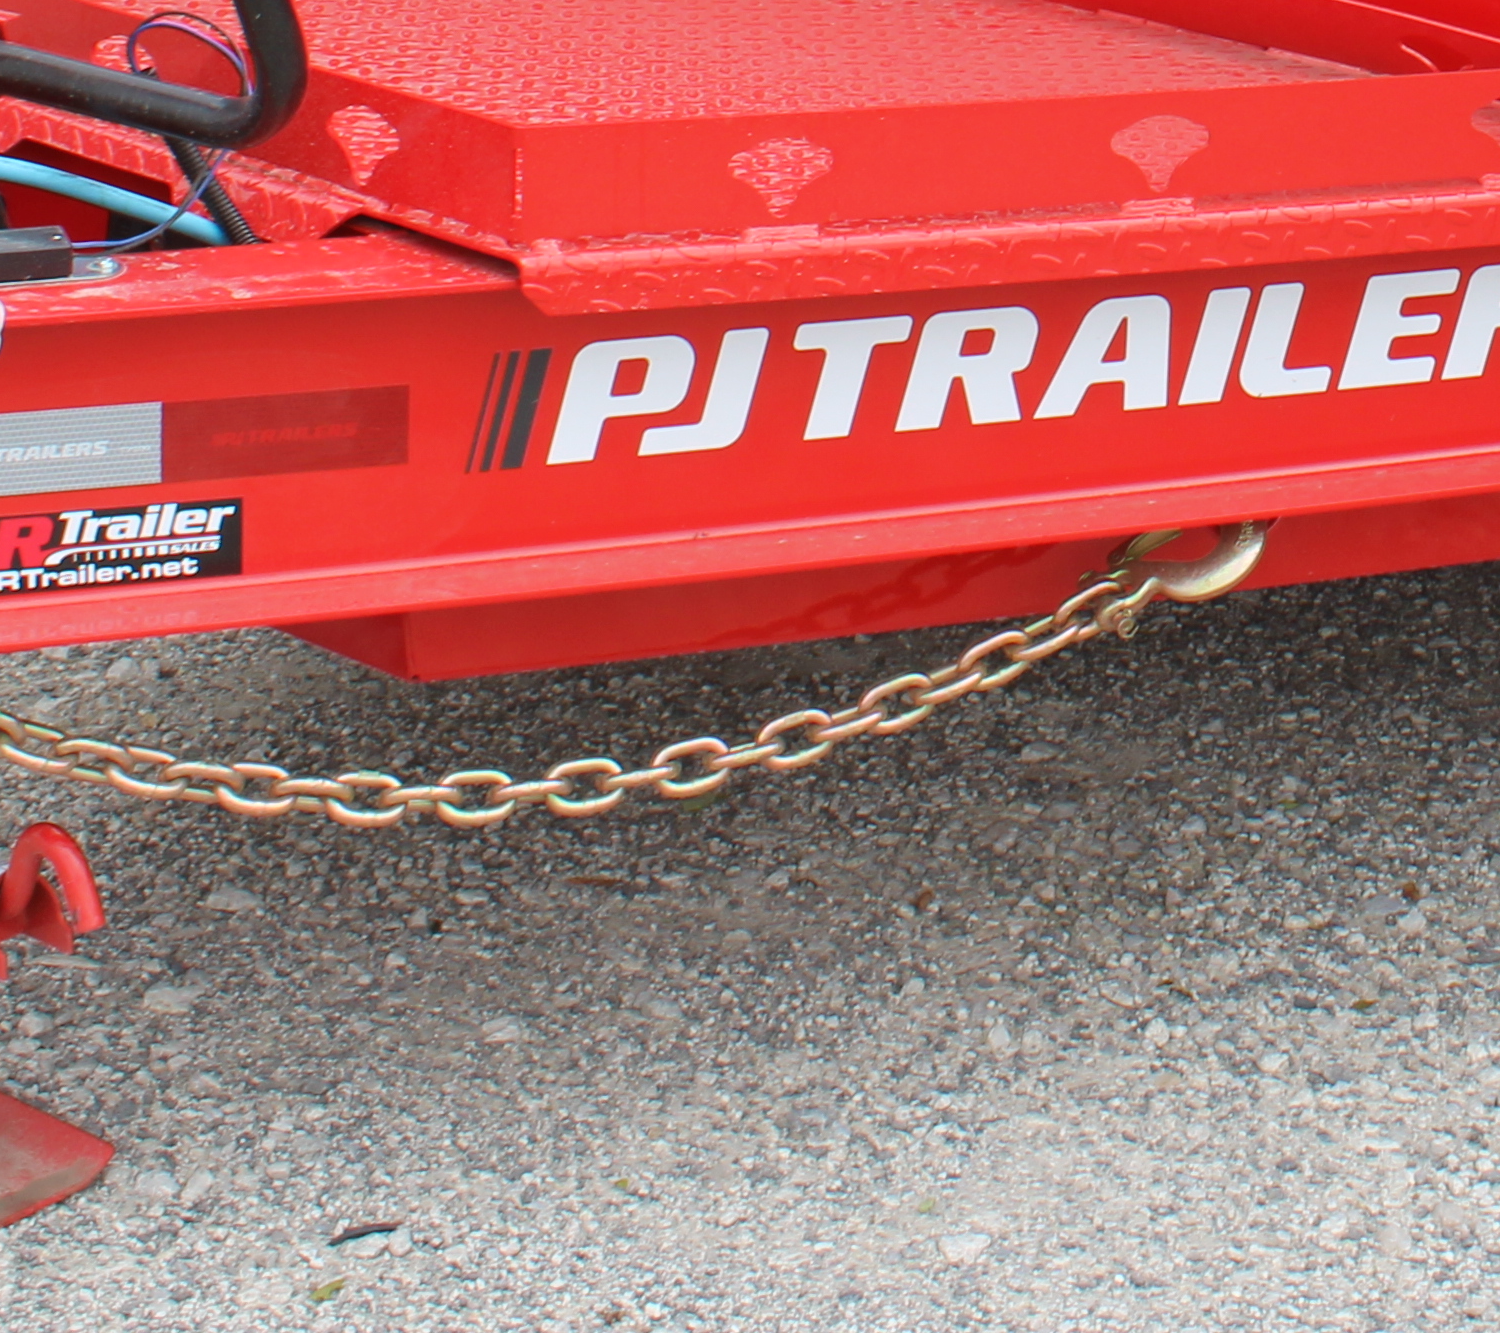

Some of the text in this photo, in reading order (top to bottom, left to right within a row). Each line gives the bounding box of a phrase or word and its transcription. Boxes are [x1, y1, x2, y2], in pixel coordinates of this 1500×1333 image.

[546, 326, 770, 466] PJ
[58, 502, 237, 546] Trailer
[170, 539, 220, 555] SALES
